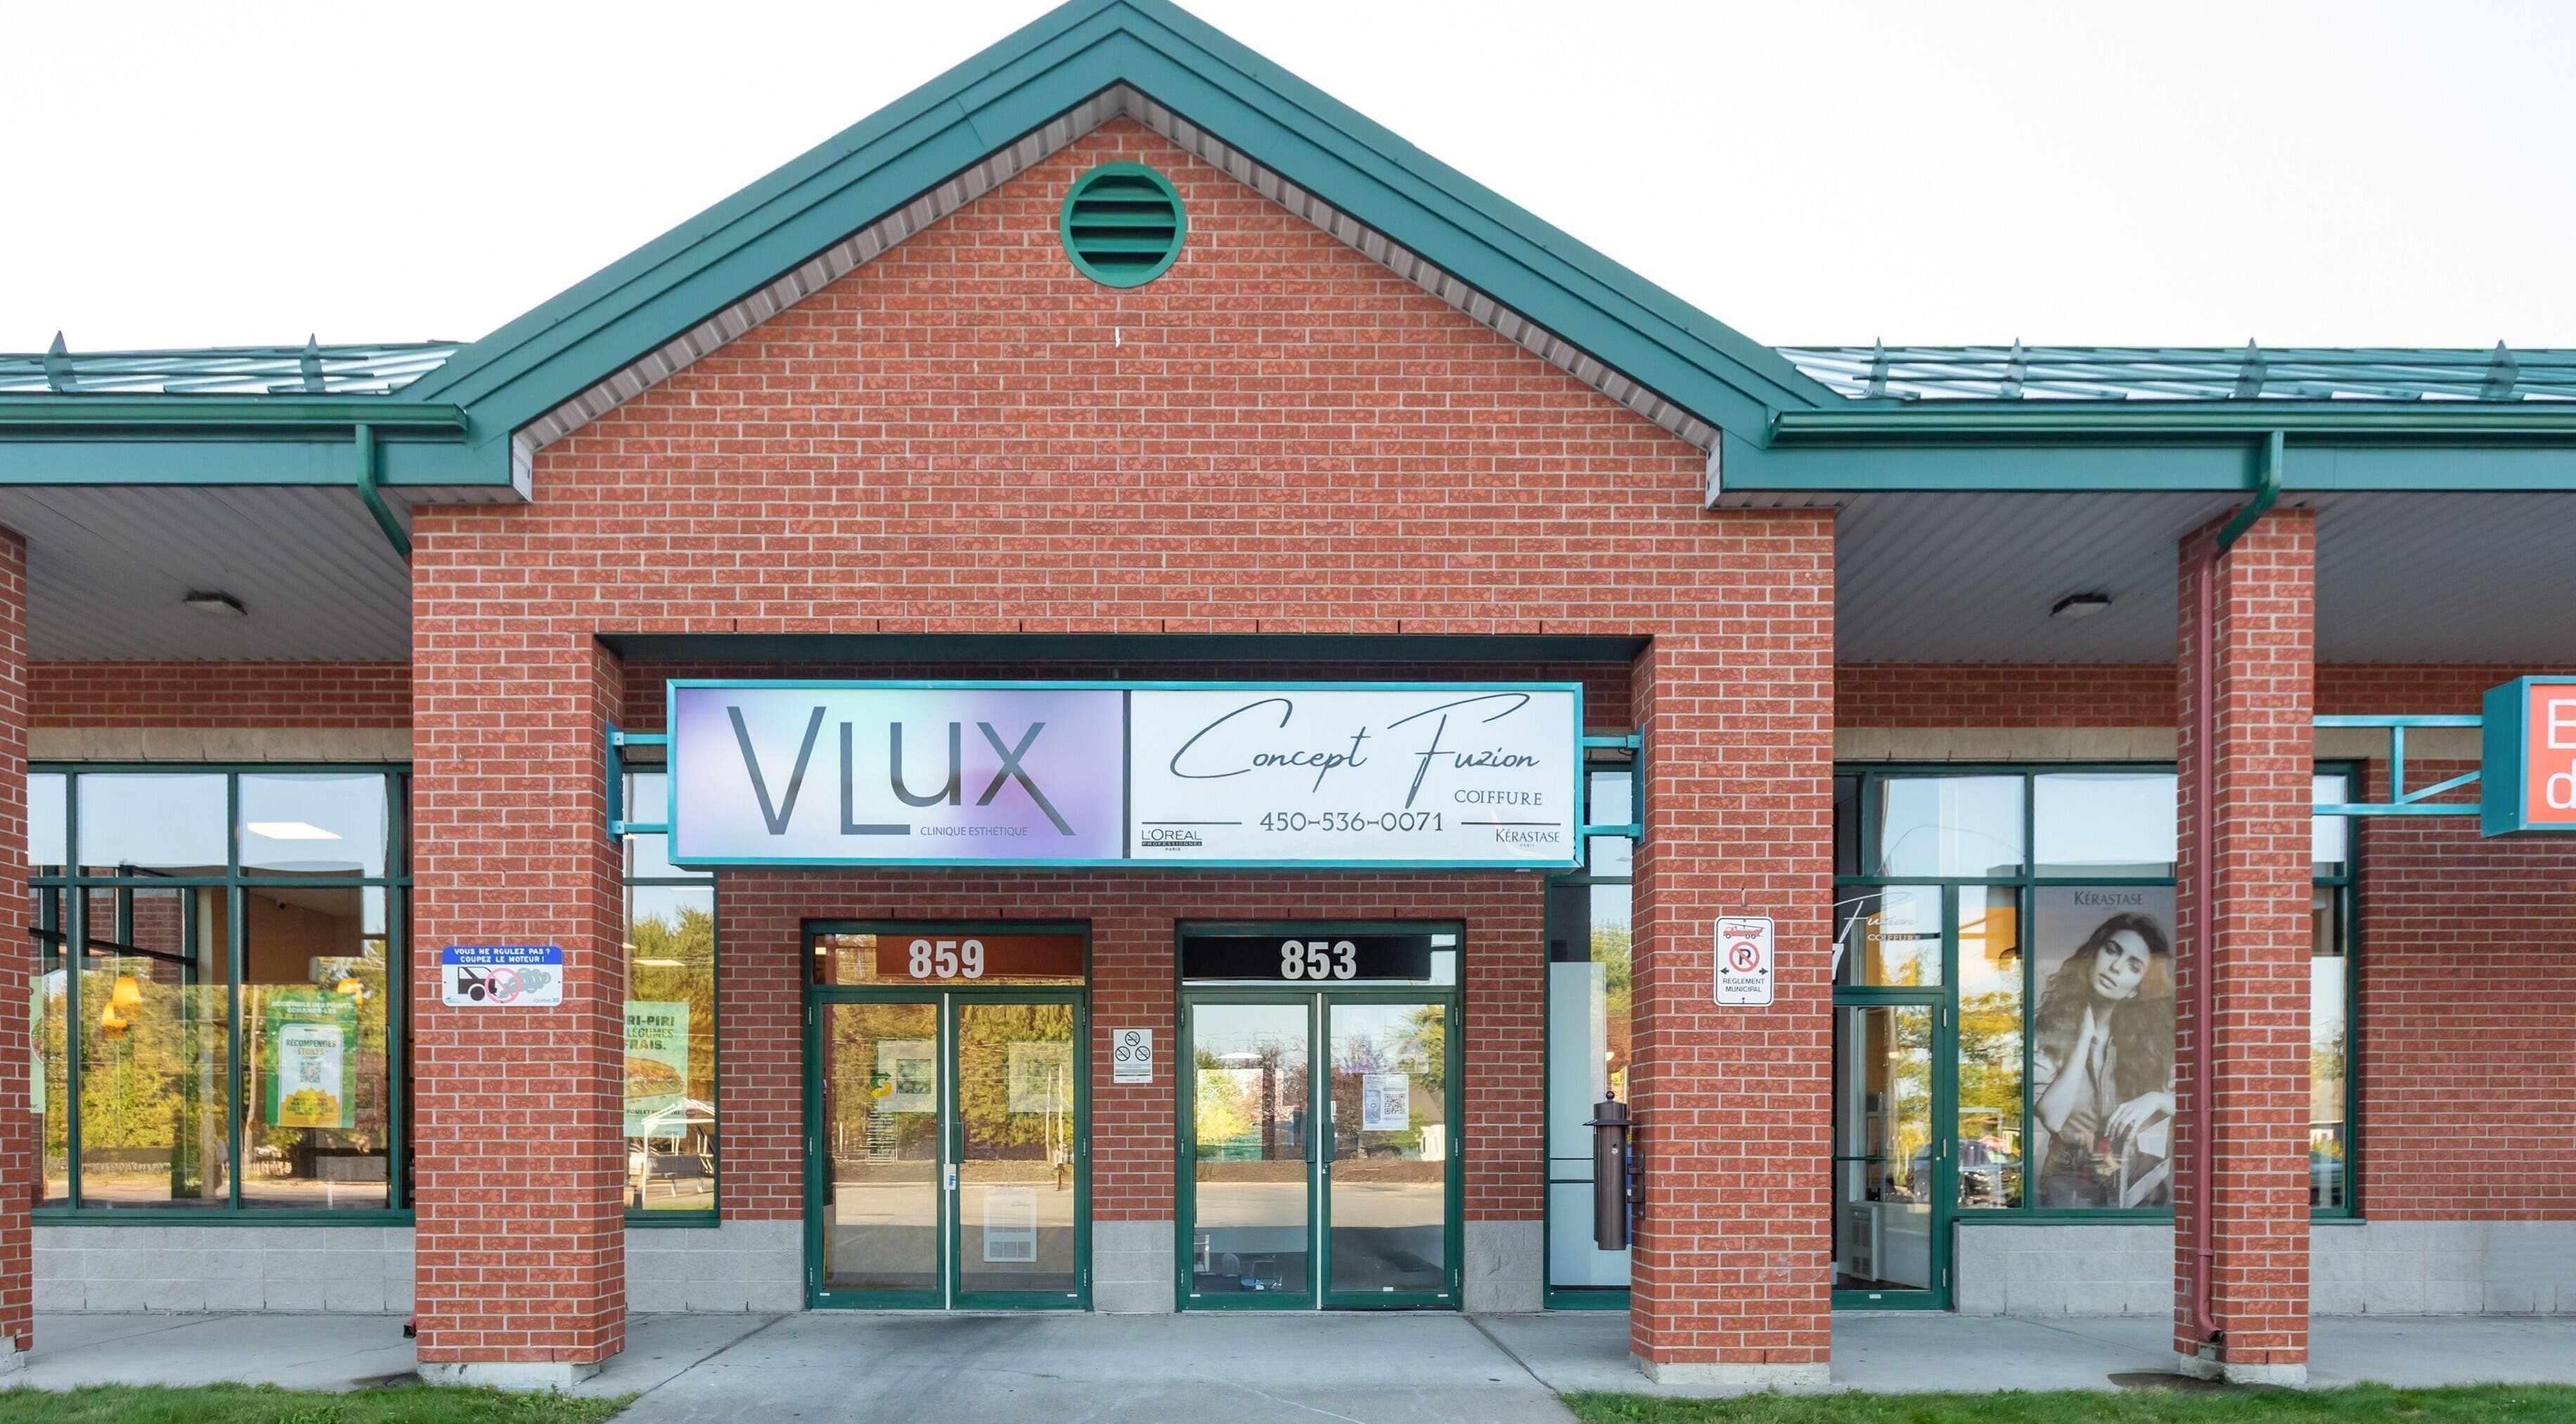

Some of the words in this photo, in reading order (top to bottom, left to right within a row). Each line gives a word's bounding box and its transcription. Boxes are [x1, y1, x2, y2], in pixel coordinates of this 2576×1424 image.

[1170, 698, 1370, 794] Concept
[1387, 693, 1540, 809] Fuzion
[1454, 789, 1543, 805] COIFFURE
[1260, 812, 1443, 832] 450-536-0071
[920, 826, 967, 836] CLINIQUE
[969, 824, 1028, 836] ESTHÉTIQUE
[1496, 828, 1560, 843] KÉRASTASE
[2075, 891, 2144, 905] KÉRASTASE
[909, 939, 984, 978] 859
[1281, 940, 1357, 980] 853
[624, 1015, 675, 1026] RI-PIRI
[627, 1025, 674, 1039] LÉGUMES
